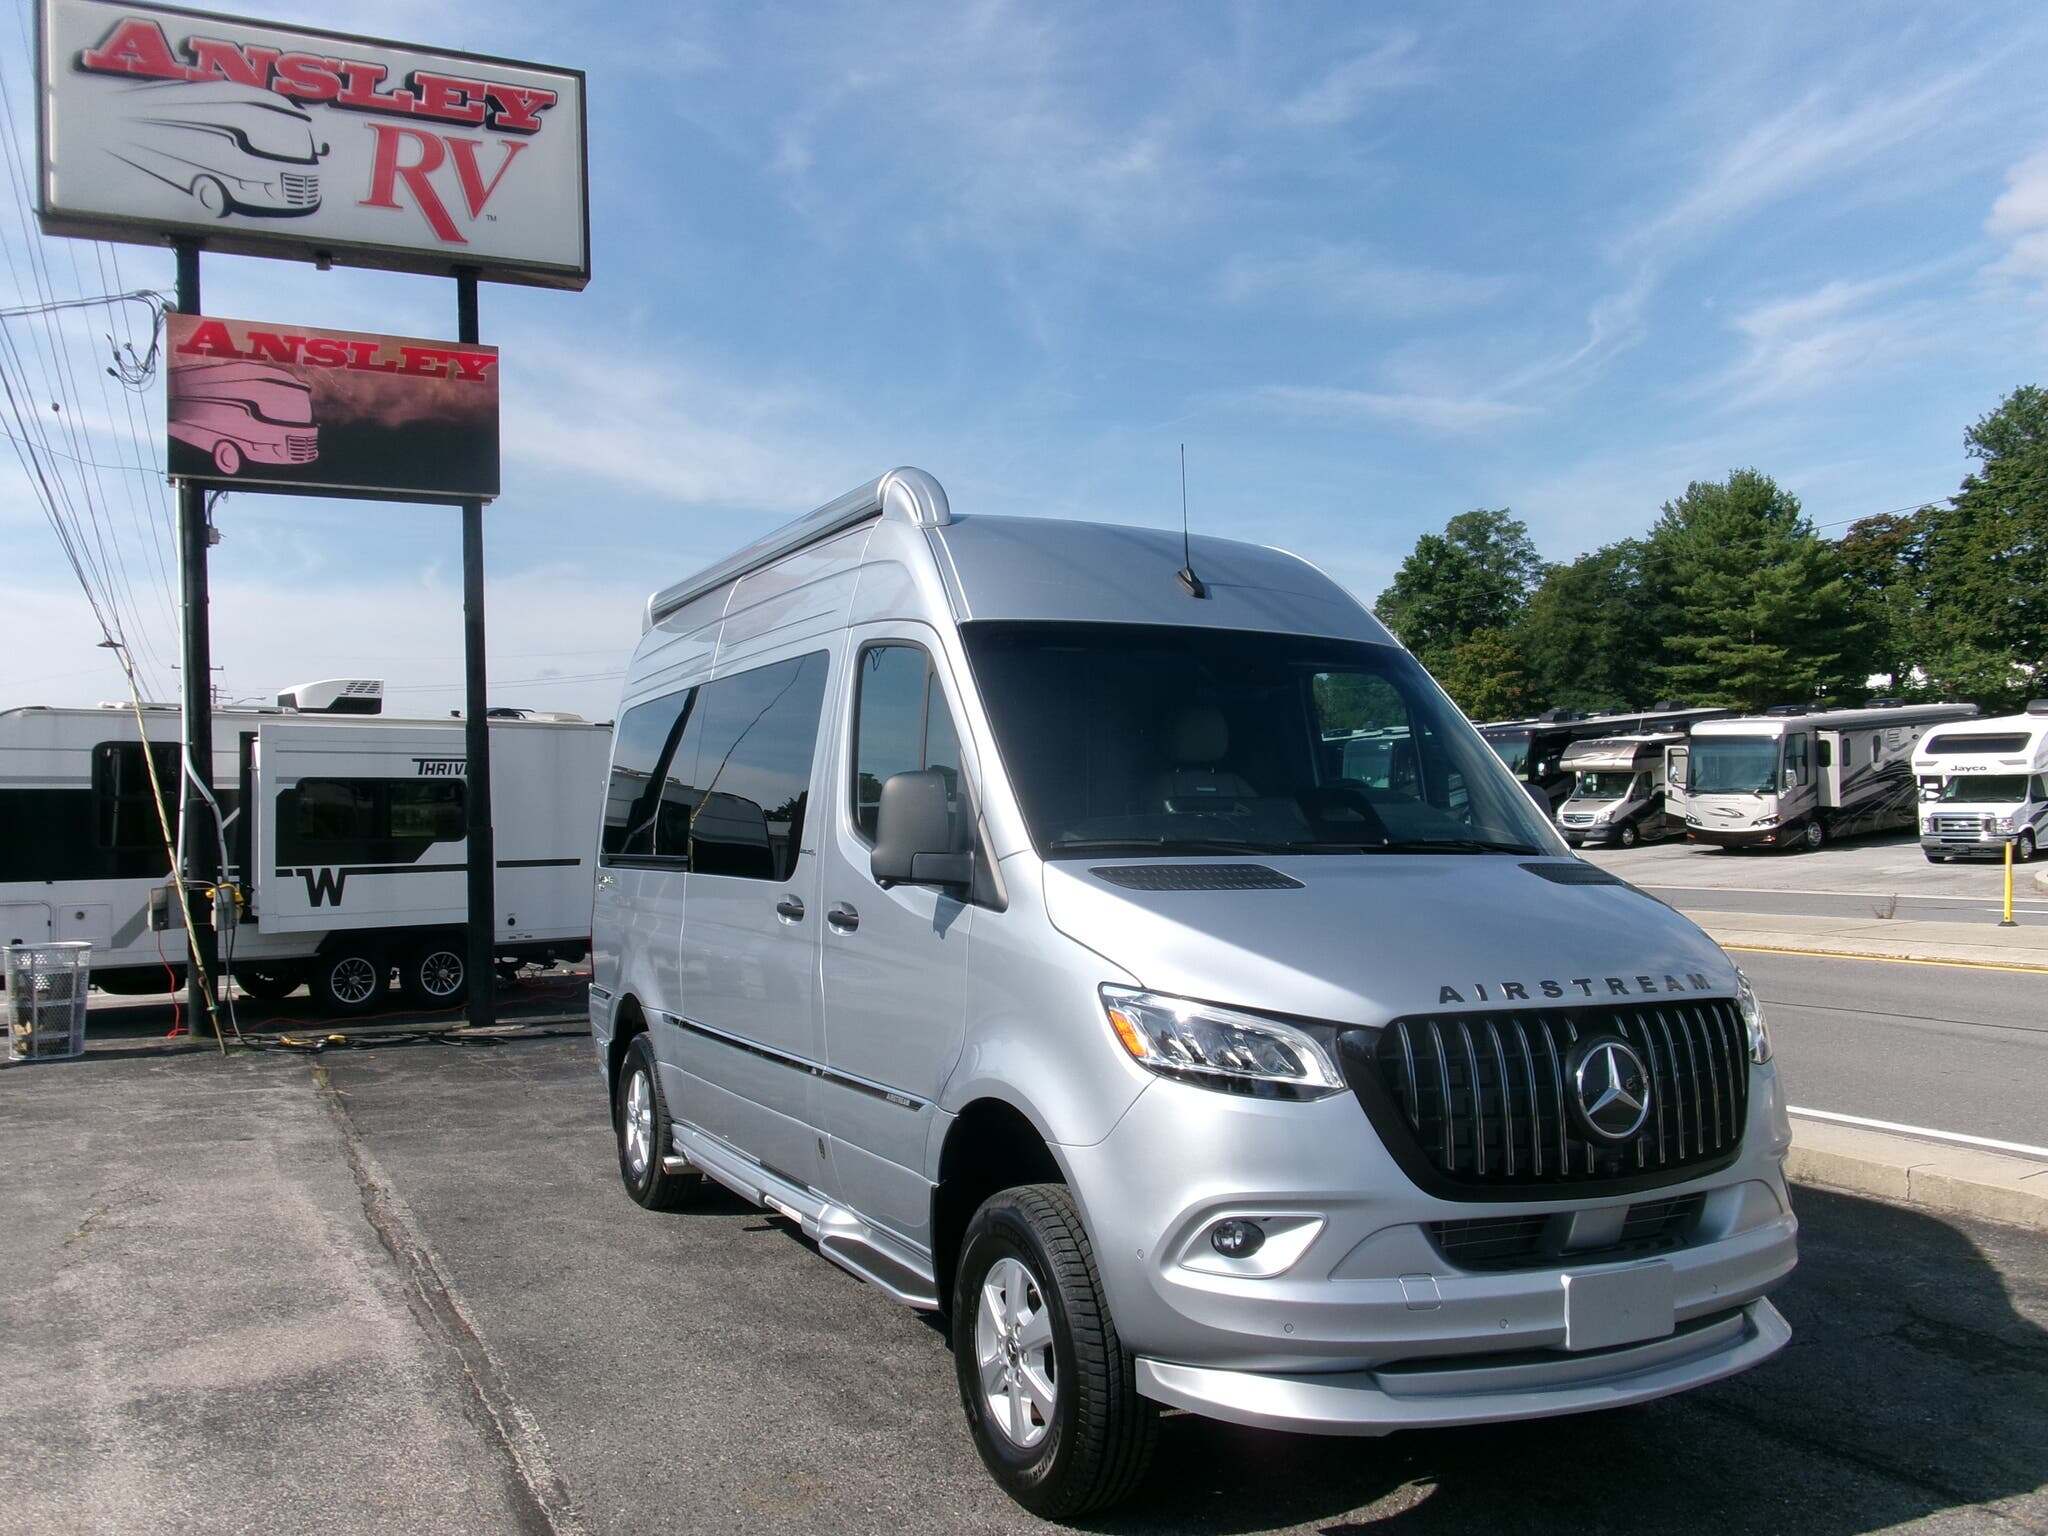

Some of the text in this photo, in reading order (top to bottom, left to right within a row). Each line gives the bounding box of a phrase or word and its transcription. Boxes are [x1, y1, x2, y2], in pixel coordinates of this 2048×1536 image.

[80, 17, 558, 133] ANSLEY
[358, 121, 529, 245] RV
[175, 319, 497, 383] ANSLEY
[411, 758, 467, 776] THRIV
[1950, 765, 1988, 773] Jayco
[303, 867, 347, 908] W
[1438, 972, 1712, 1005] AIRSTREAM
